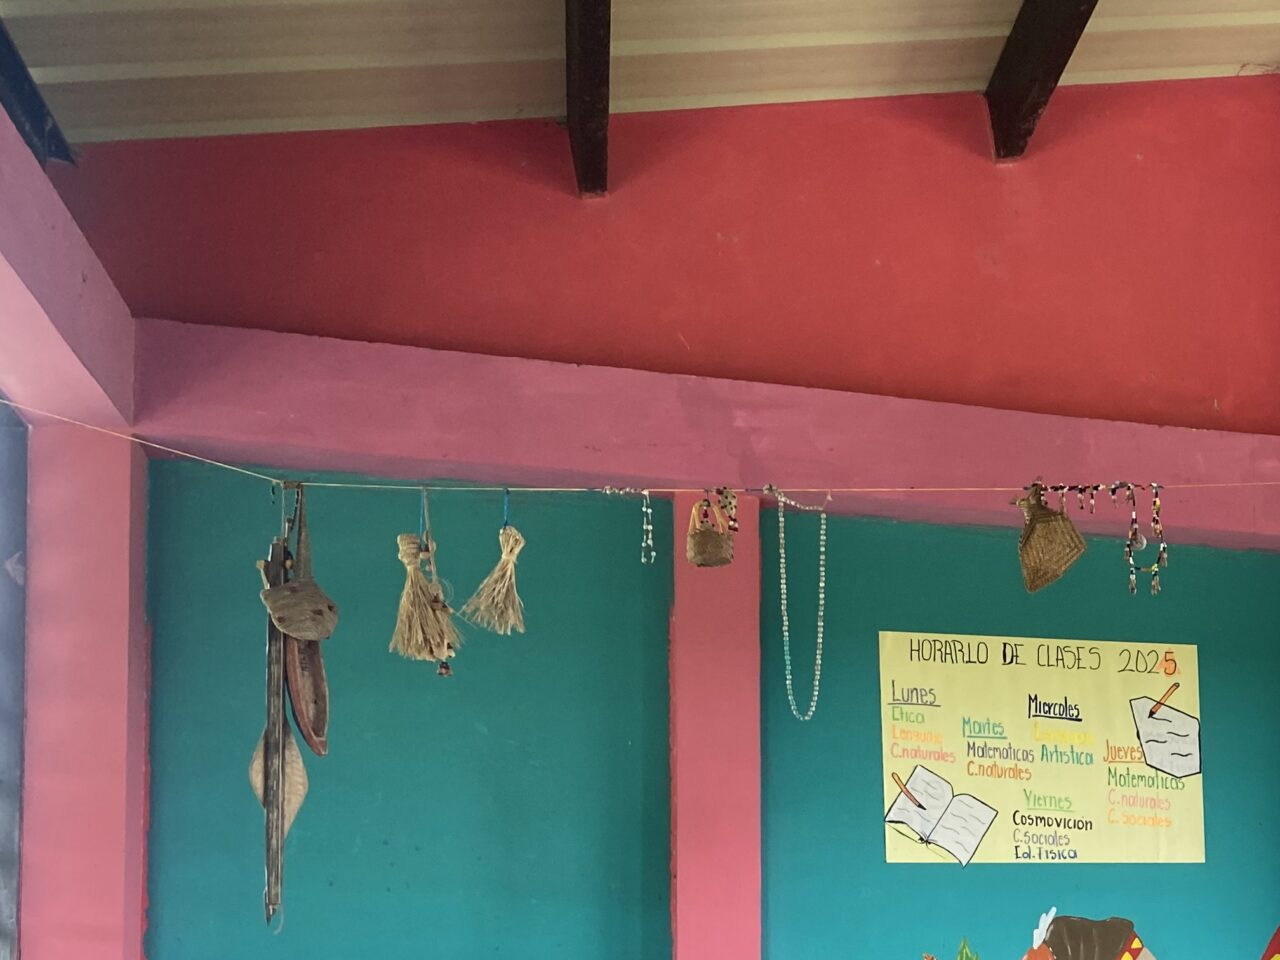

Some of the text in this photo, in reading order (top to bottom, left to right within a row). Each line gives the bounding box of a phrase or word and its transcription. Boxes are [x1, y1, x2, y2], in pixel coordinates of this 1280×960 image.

[1001, 642, 1028, 666] DE
[1036, 643, 1102, 670] CLASES
[1117, 649, 1179, 676] 2025
[891, 679, 938, 706] Lunes
[961, 715, 1006, 737] Martes
[966, 741, 1095, 766] Matematicas Artistica
[1103, 739, 1144, 762] Jueves
[1107, 766, 1186, 791] Matematicas
[1023, 788, 1073, 810] Viernes
